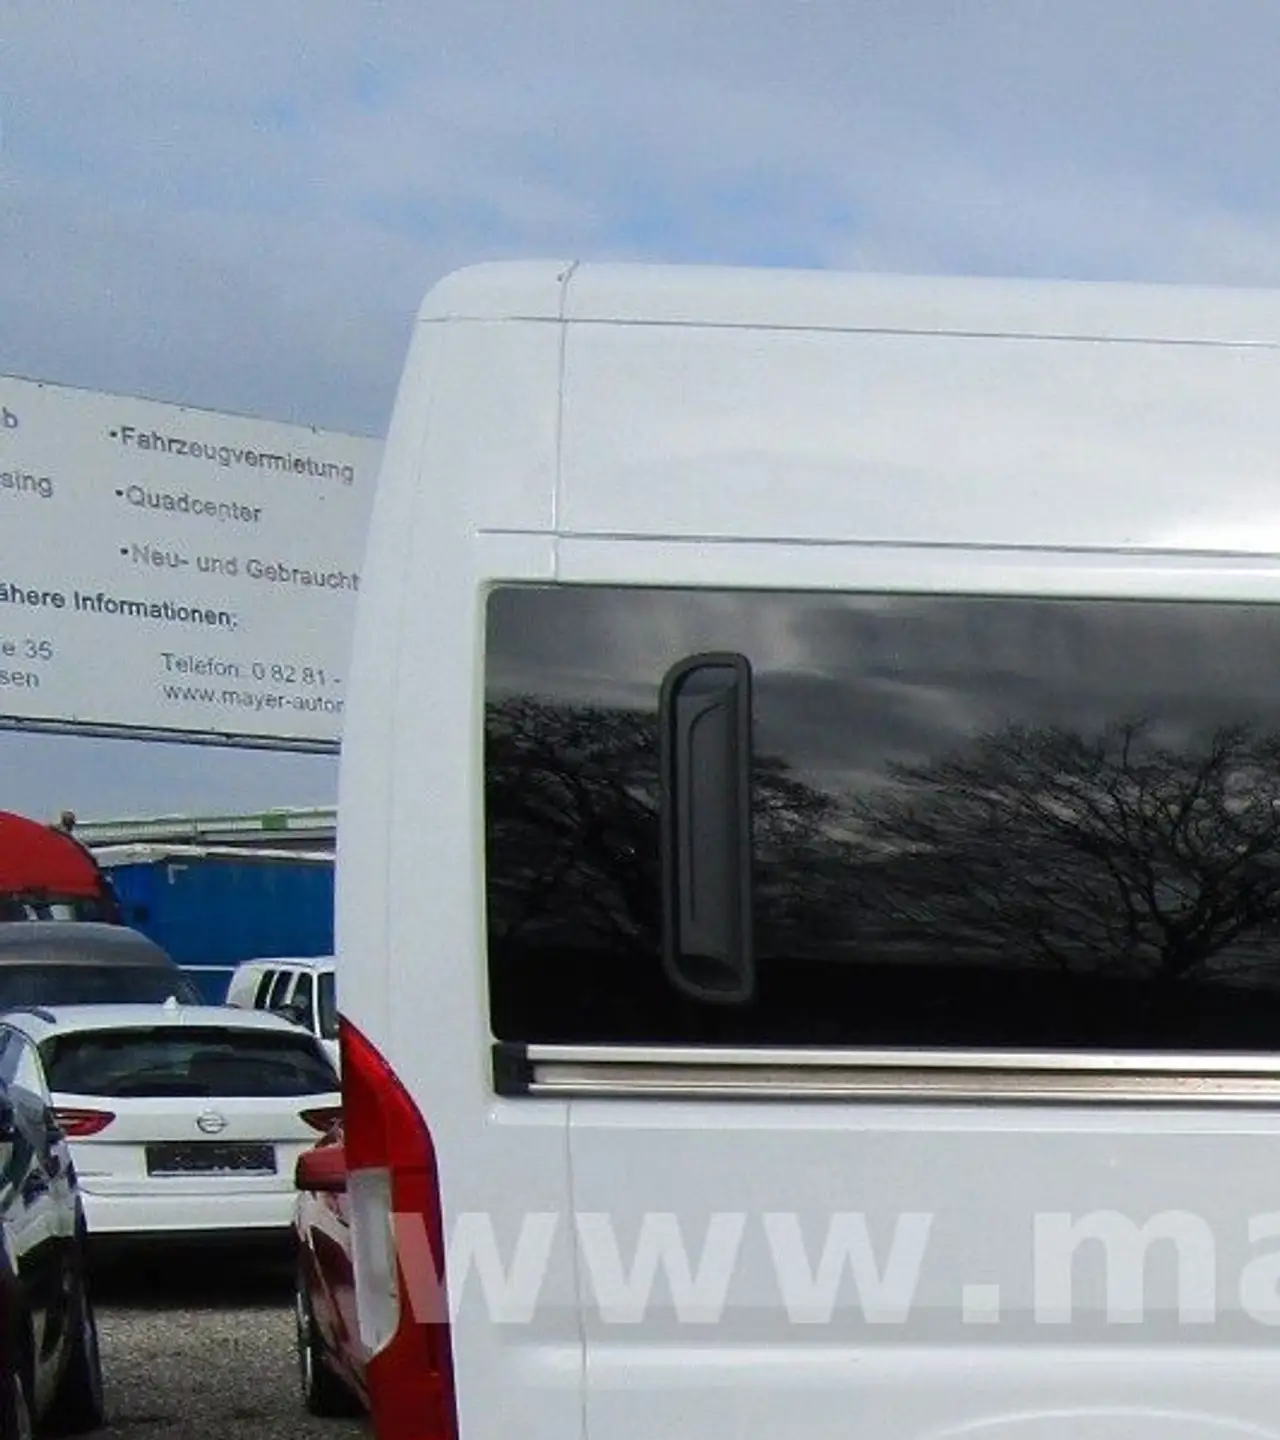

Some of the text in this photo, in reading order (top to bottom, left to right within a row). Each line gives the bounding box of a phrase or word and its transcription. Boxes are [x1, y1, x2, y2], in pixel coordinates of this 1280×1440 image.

[121, 427, 354, 485] Fahrzeugvermietung
[125, 485, 262, 523] Quadcenter
[132, 543, 189, 568] Neu-
[196, 556, 239, 577] und
[251, 662, 266, 681] 0
[271, 664, 297, 684] 82
[301, 666, 326, 686] 81
